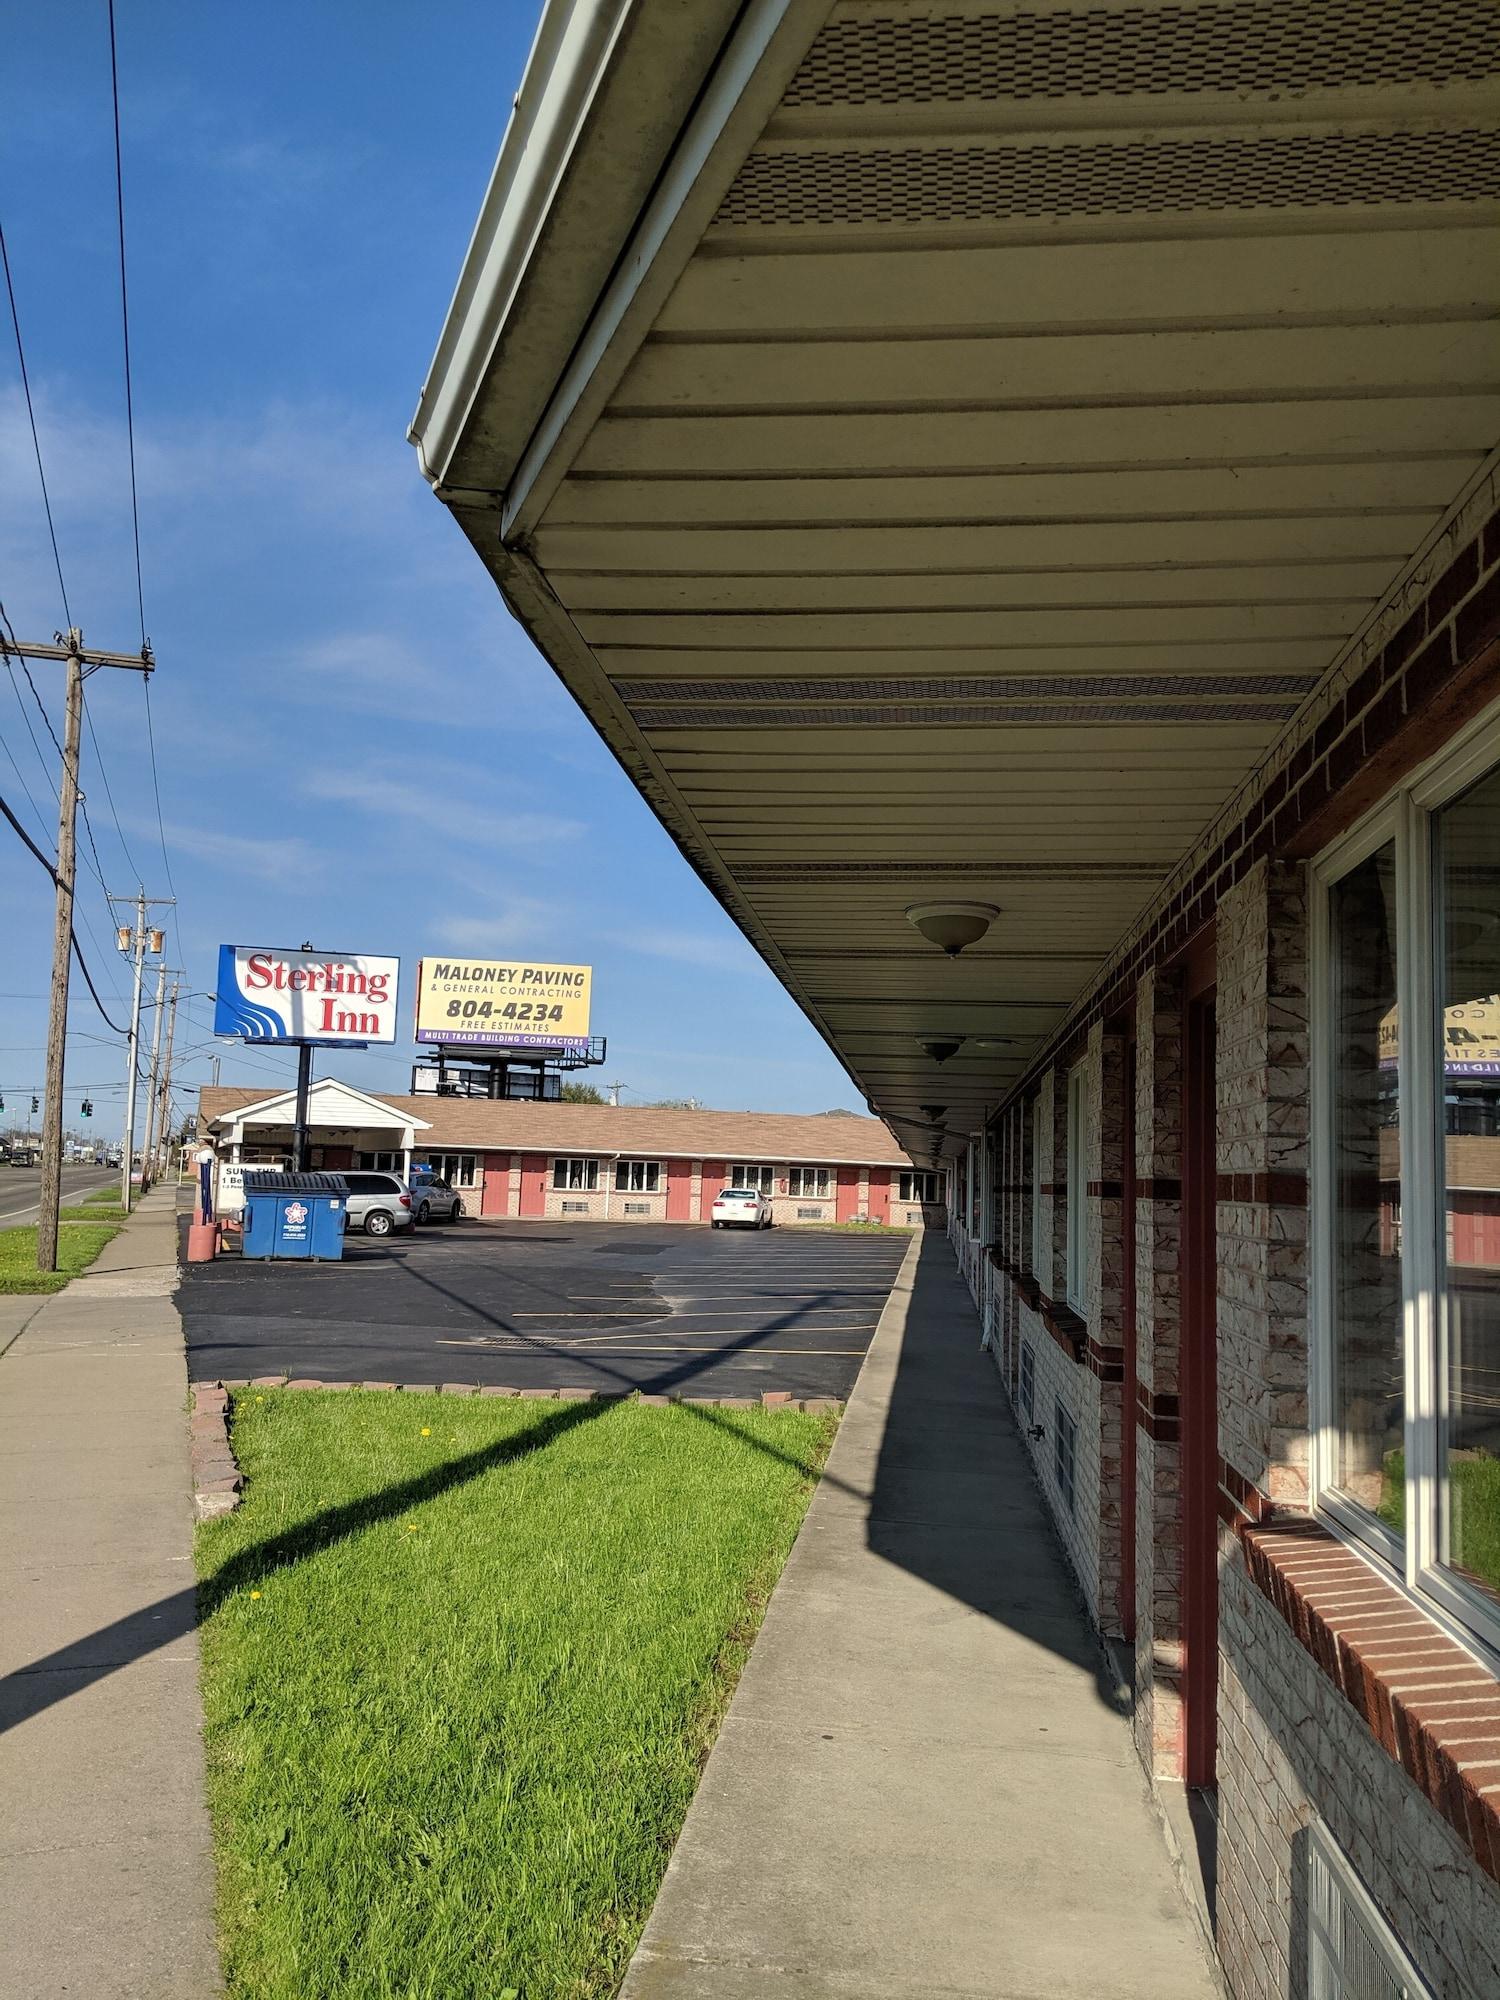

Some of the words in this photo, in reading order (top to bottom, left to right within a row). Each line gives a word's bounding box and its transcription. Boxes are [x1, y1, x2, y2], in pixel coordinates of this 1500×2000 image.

[246, 953, 391, 1004] Sterling
[433, 964, 518, 983] MALONEY
[521, 968, 585, 987] PAVING
[431, 983, 437, 991] &
[443, 984, 494, 994] GENERAL
[500, 986, 582, 999] CONTRACTING
[318, 998, 380, 1034] Inn
[446, 999, 564, 1022] 804-4234
[460, 1020, 486, 1029] FREE
[491, 1021, 550, 1033] ESTIMATES
[424, 1032, 450, 1040] MULTI
[452, 1033, 478, 1041] TRADE
[481, 1034, 520, 1043] BUILDING
[523, 1036, 584, 1046] CONTRACTORS
